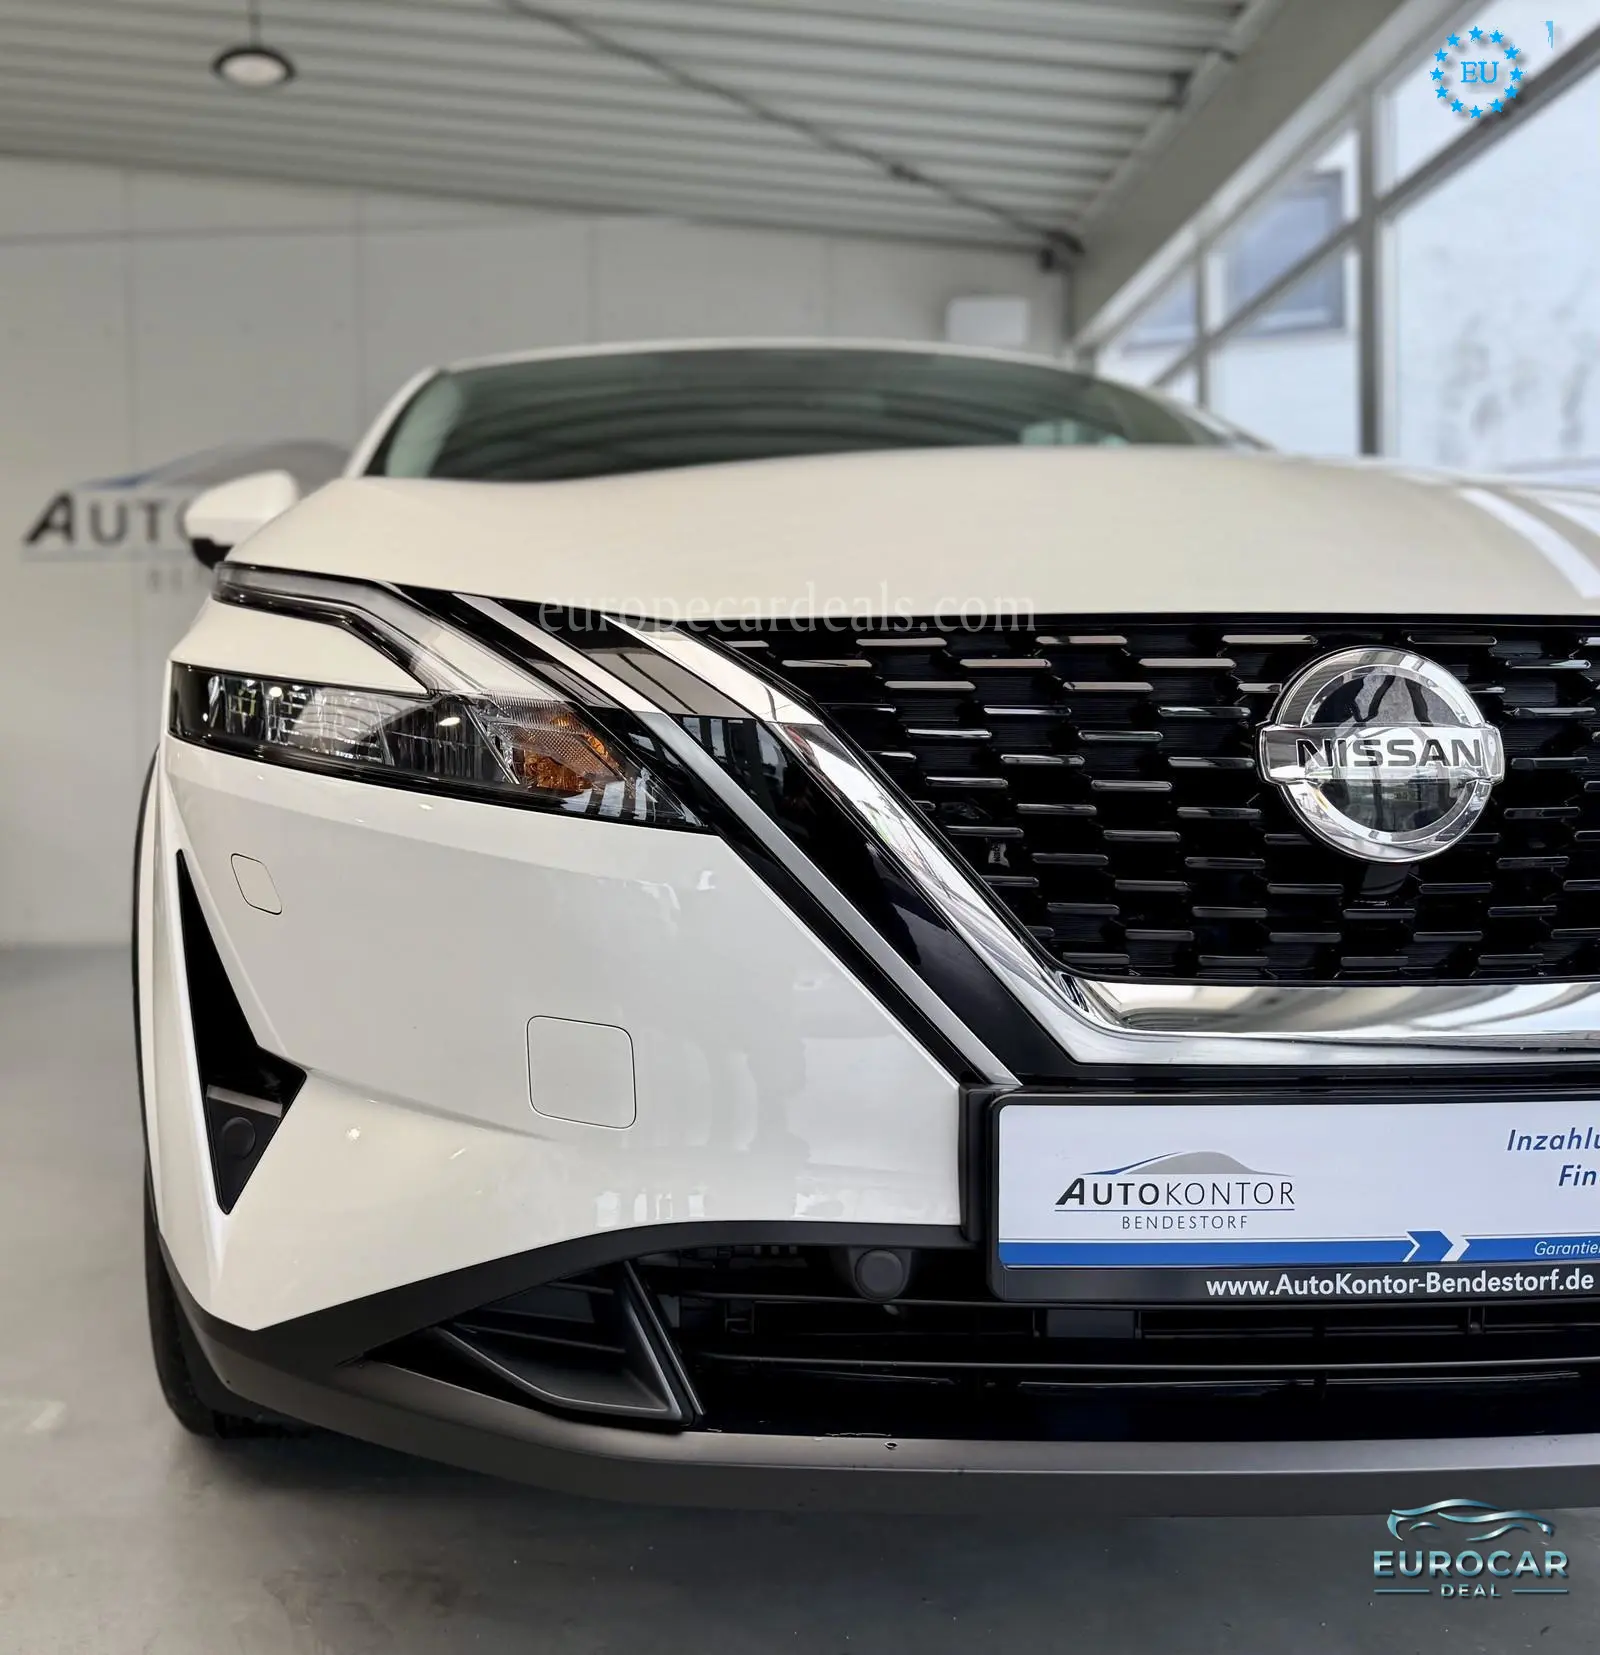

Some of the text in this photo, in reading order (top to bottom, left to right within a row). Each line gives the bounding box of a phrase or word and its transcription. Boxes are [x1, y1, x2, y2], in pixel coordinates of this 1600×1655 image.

[22, 492, 190, 545] AUT
[1296, 739, 1483, 767] NISSAN
[1558, 1164, 1600, 1187] Fin
[1055, 1178, 1295, 1206] AUTOKONTOR
[1121, 1215, 1248, 1230] BENDESTORF
[1534, 1240, 1600, 1256] Garantie
[1205, 1267, 1595, 1297] www.AutoKontor-Bendestorf.de
